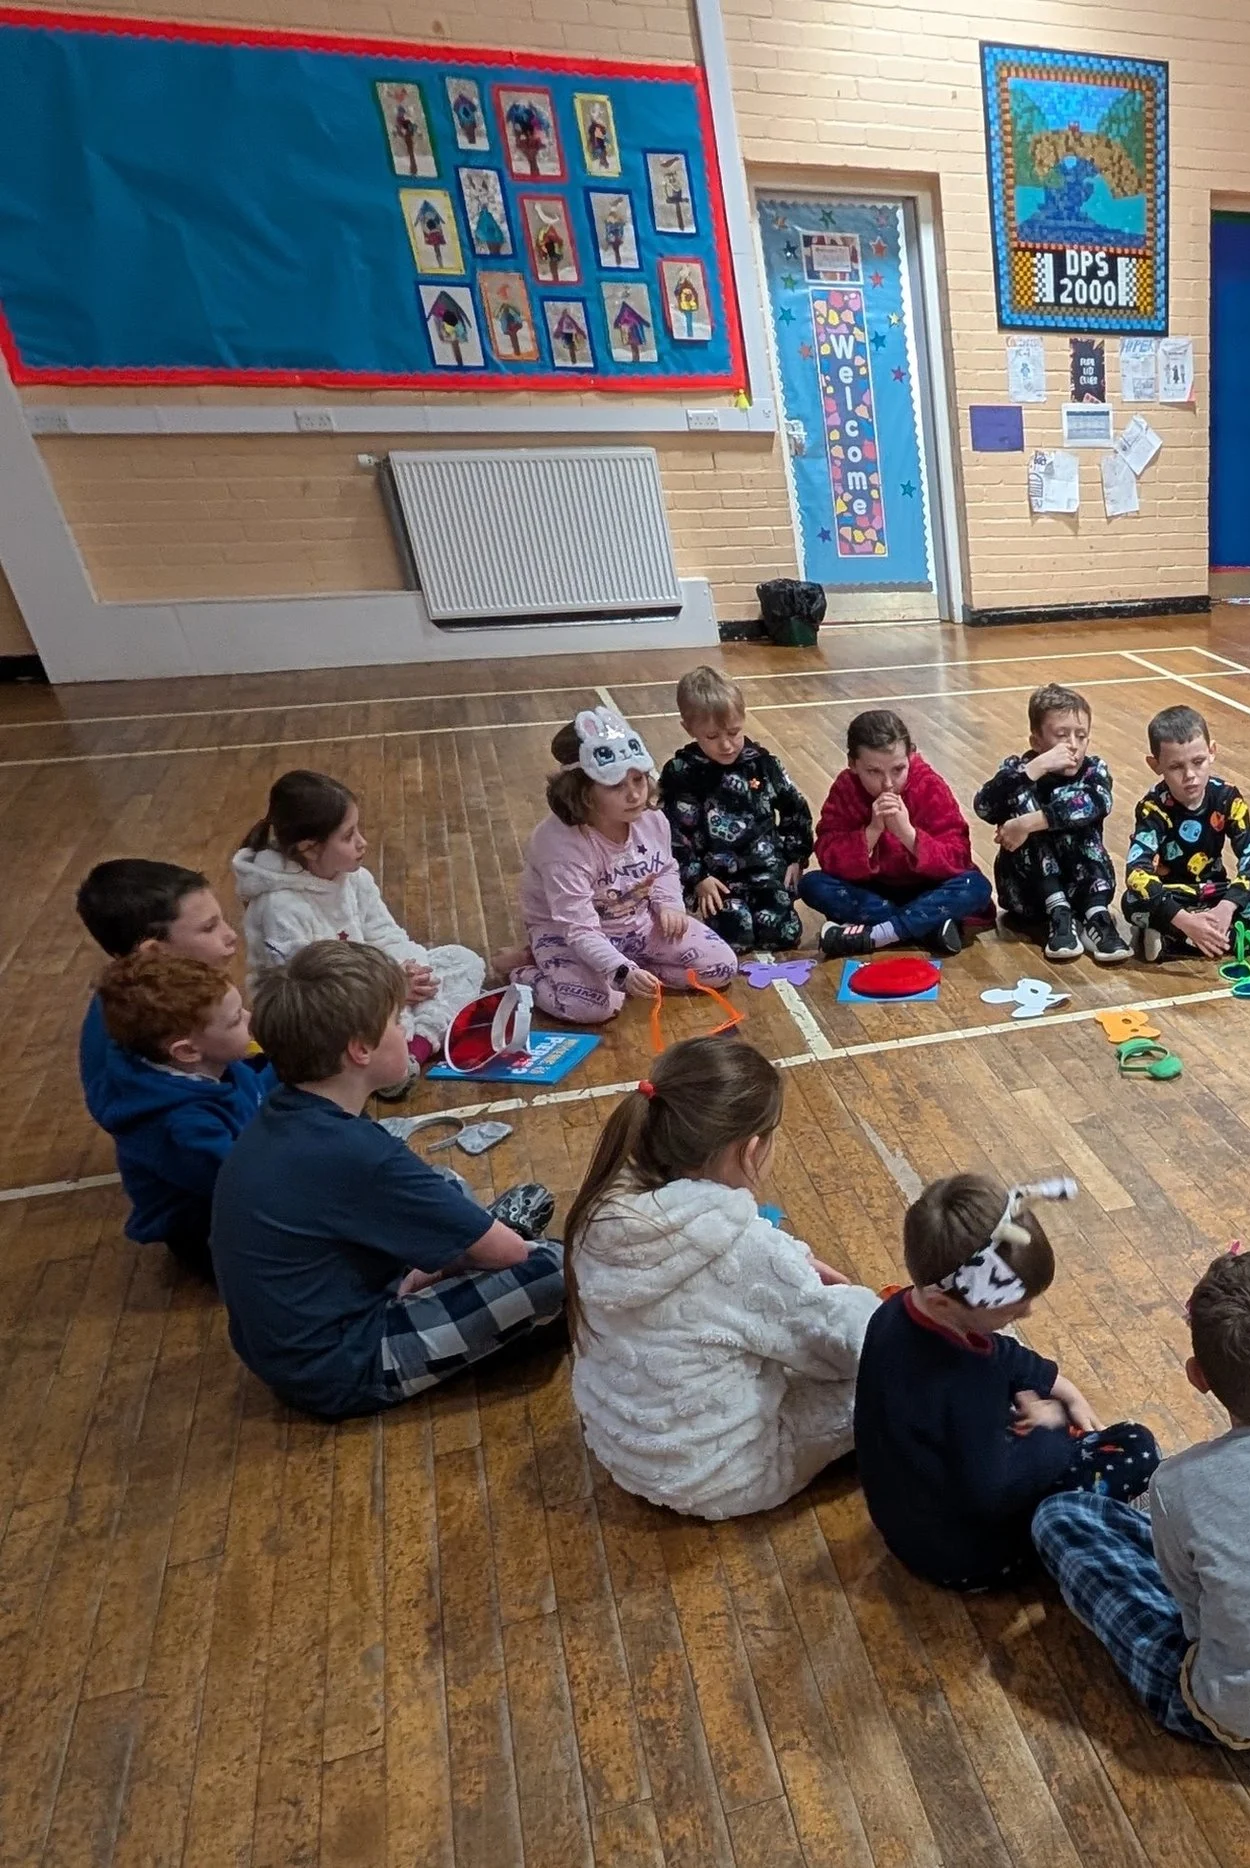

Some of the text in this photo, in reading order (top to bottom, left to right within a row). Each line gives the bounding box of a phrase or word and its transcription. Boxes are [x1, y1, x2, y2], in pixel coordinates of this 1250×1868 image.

[1066, 250, 1109, 277] DPS
[1059, 278, 1116, 306] 2000
[830, 334, 867, 515] Welcome
